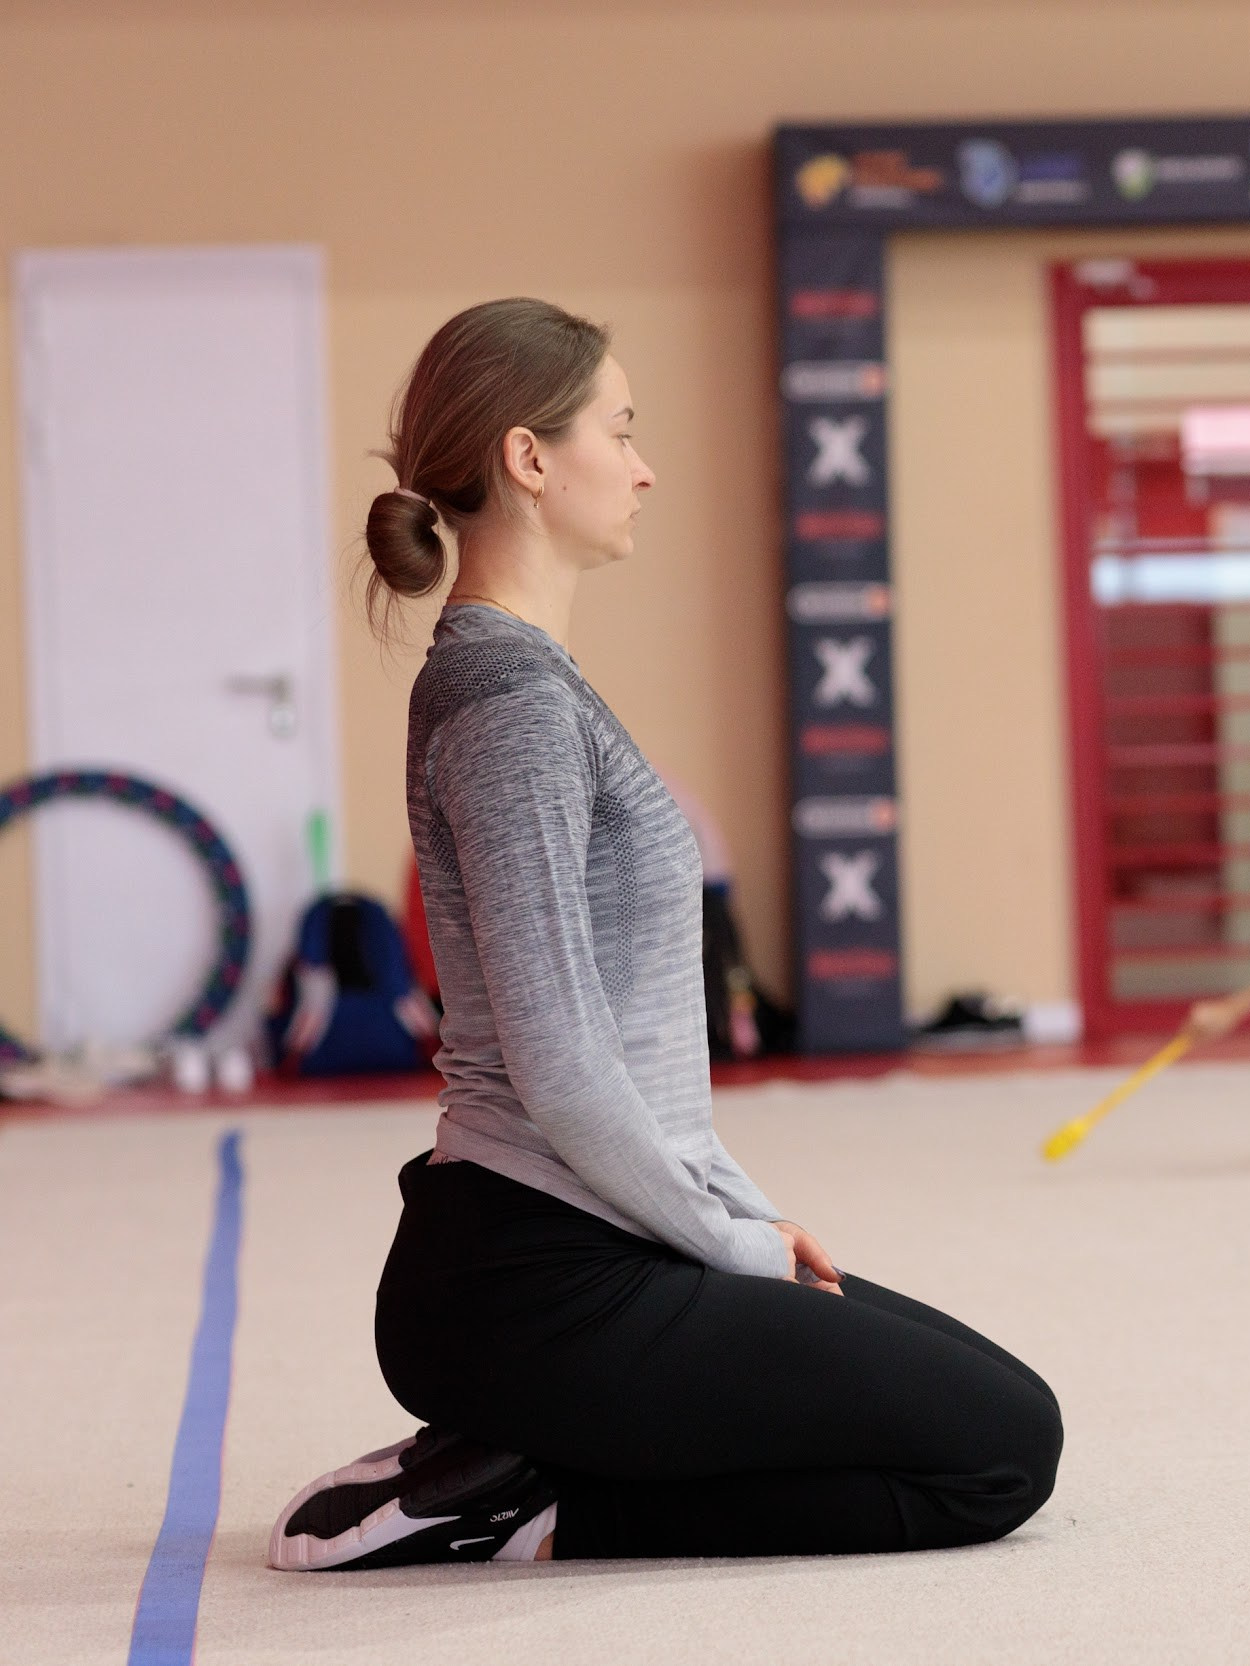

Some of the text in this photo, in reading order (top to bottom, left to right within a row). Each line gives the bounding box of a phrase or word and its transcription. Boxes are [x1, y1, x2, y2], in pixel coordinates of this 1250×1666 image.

[808, 416, 870, 486] X
[815, 638, 876, 706] X
[821, 852, 882, 921] X
